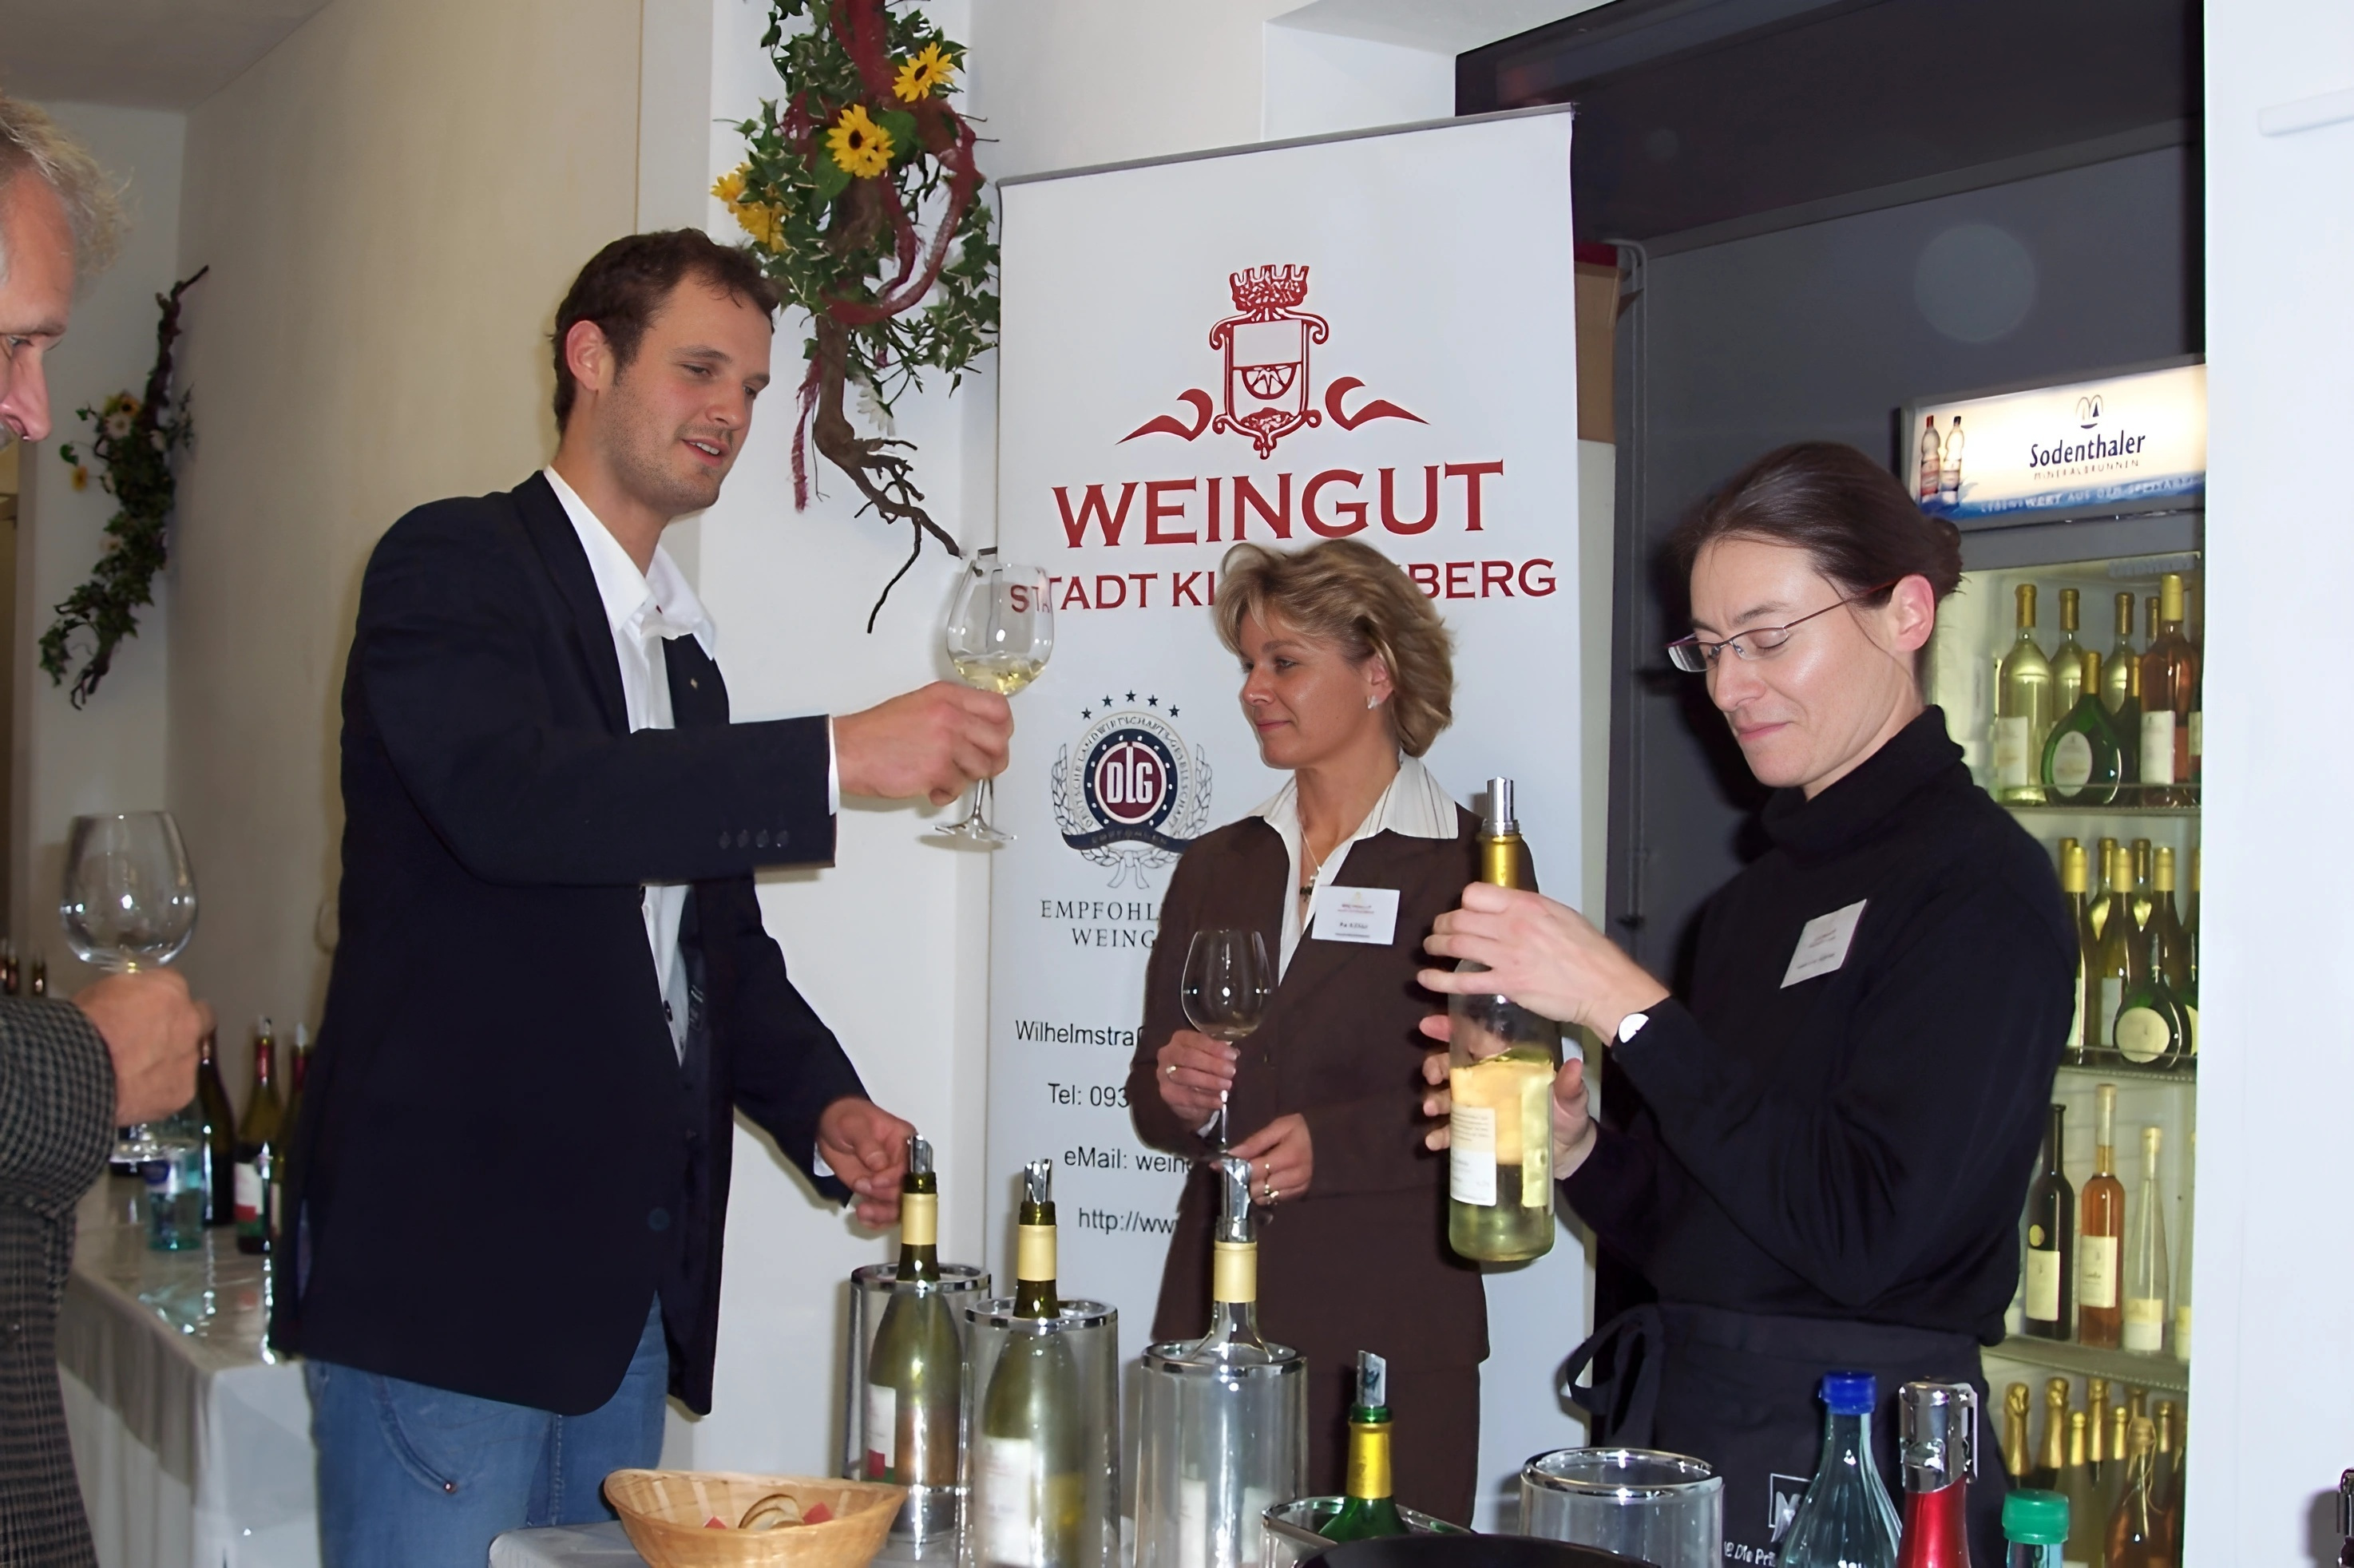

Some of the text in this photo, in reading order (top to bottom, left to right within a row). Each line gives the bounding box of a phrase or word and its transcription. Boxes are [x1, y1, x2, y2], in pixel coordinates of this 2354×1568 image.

[2029, 429, 2146, 468] Sodenthaler
[1052, 458, 1504, 548] WEINGUT
[1107, 746, 1153, 803] DLG
[1040, 900, 1159, 921] EMPFOHL
[1072, 929, 1155, 948] WEING
[1048, 1083, 1129, 1107] Tel: 093
[1064, 1146, 1127, 1169] eMail:
[1079, 1207, 1176, 1234] http://ww
